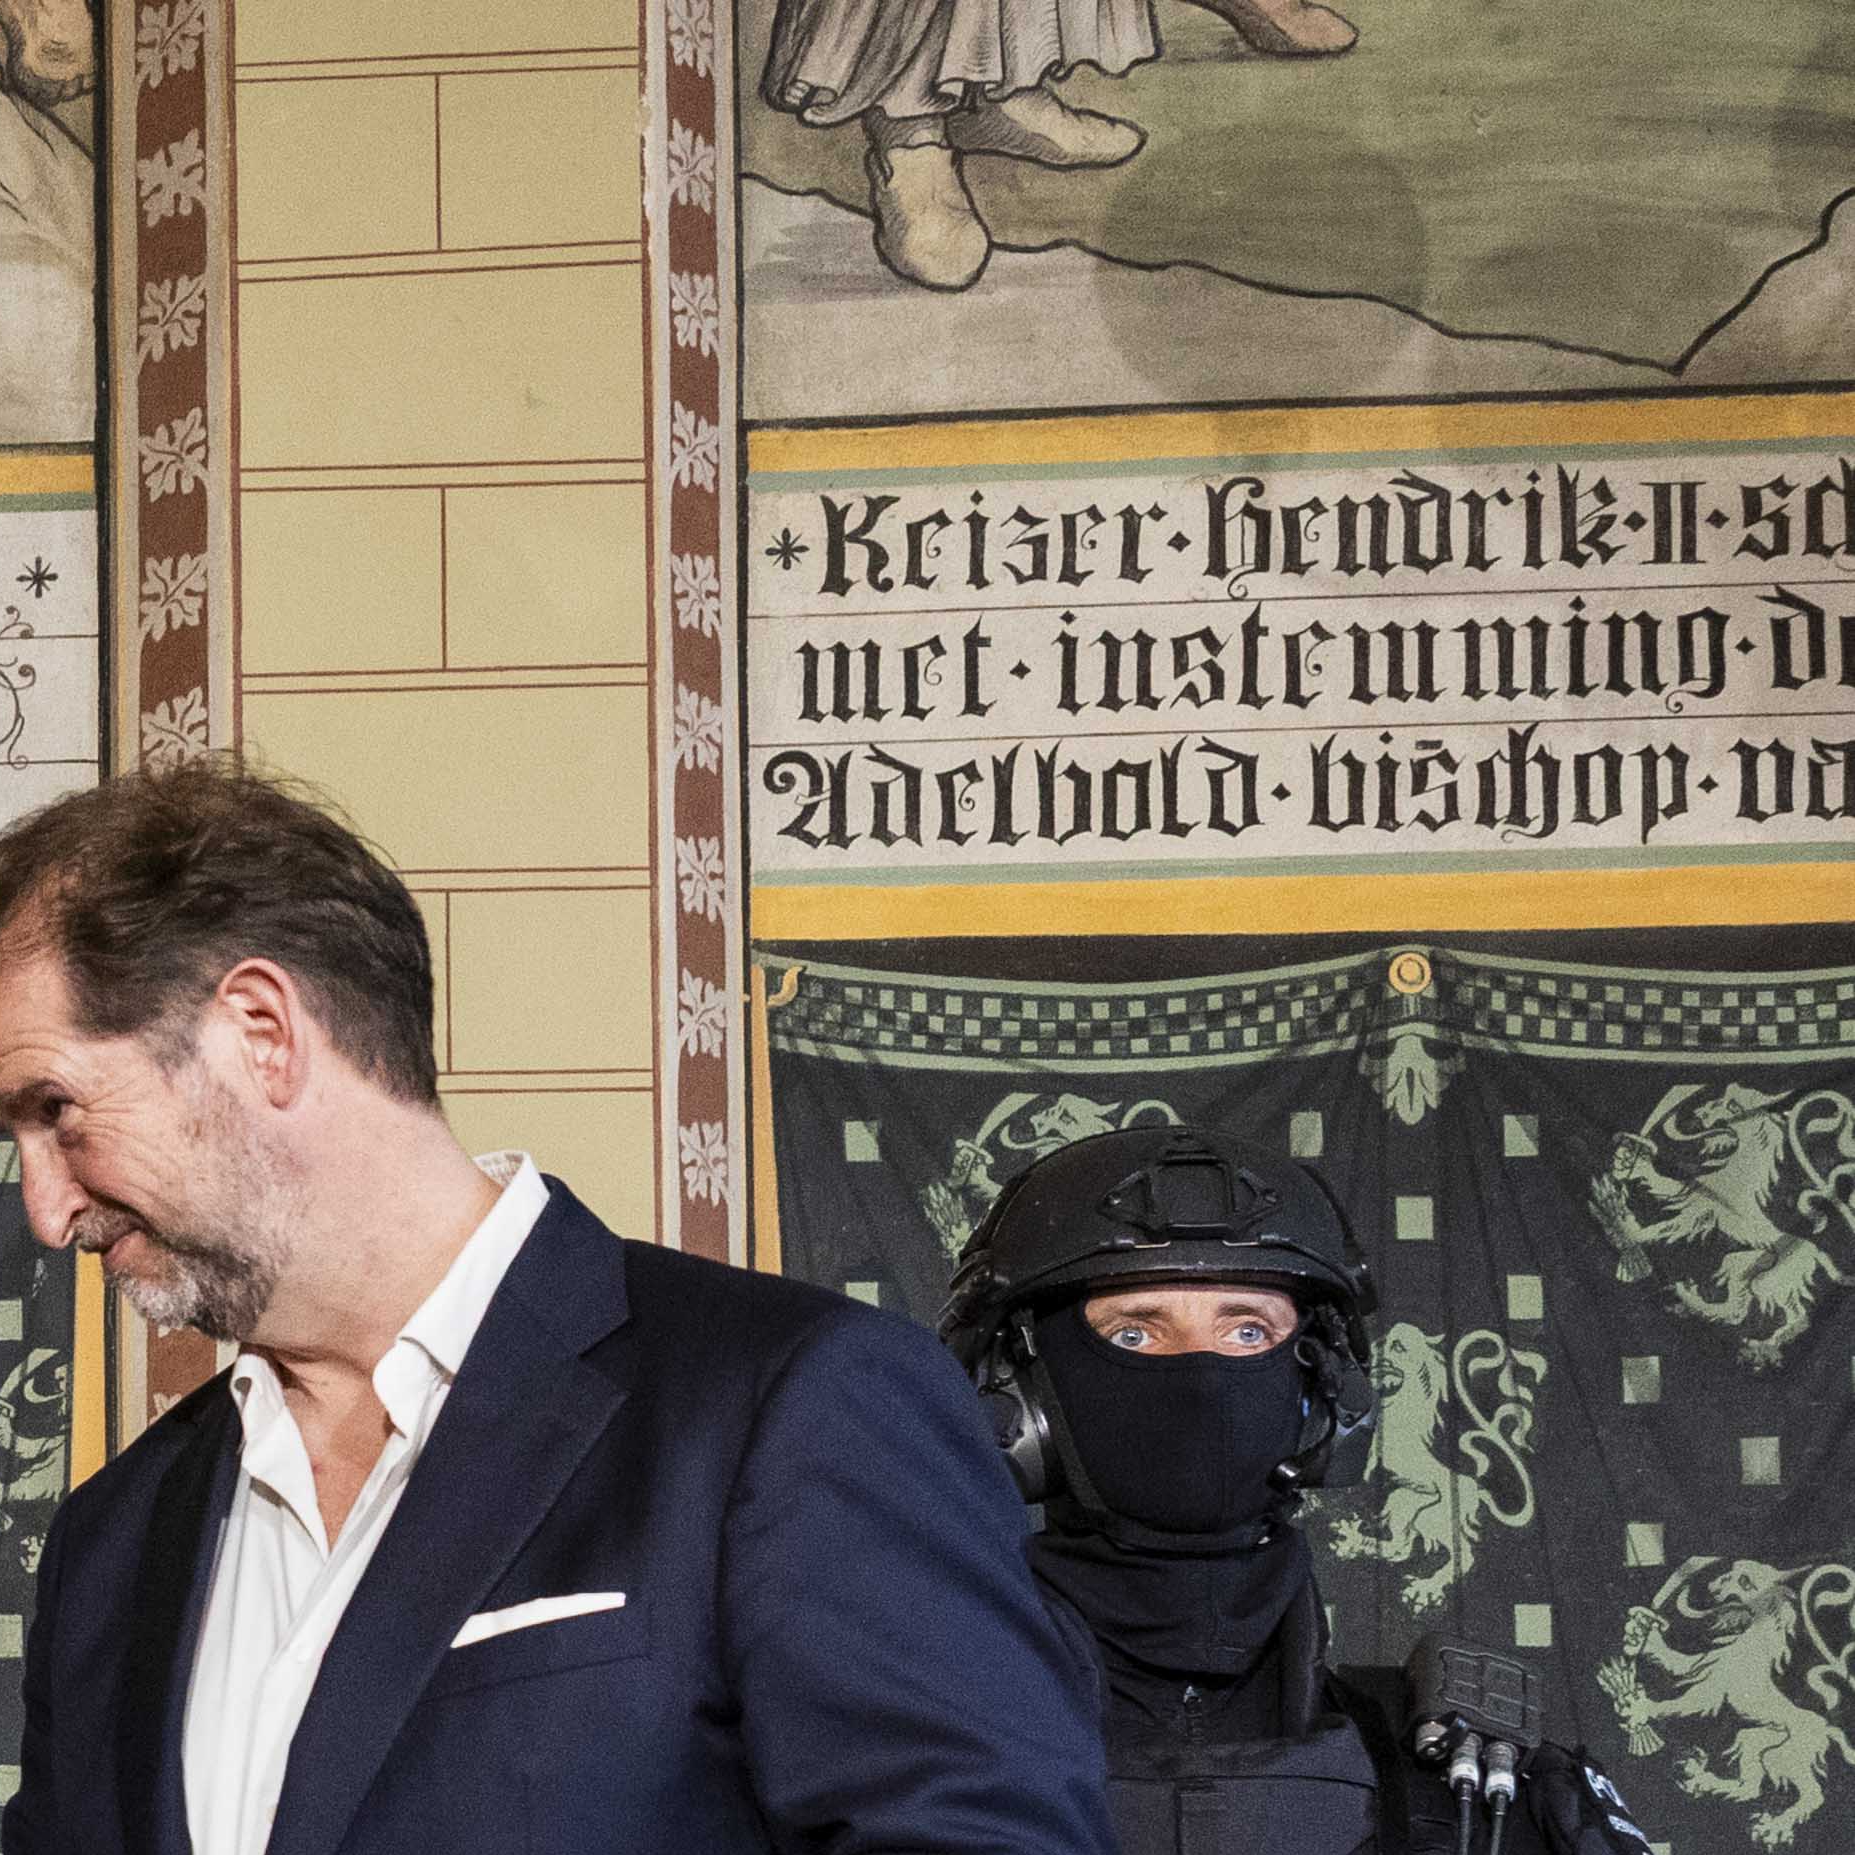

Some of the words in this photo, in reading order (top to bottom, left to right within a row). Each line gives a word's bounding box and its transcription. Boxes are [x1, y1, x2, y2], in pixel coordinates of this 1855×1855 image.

[818, 490, 1168, 597] Keizer
[1638, 481, 1707, 565] II
[794, 613, 997, 723] met
[1052, 595, 1731, 716] instemming
[763, 735, 1265, 849] Adelbold
[1308, 721, 1690, 844] bischop
